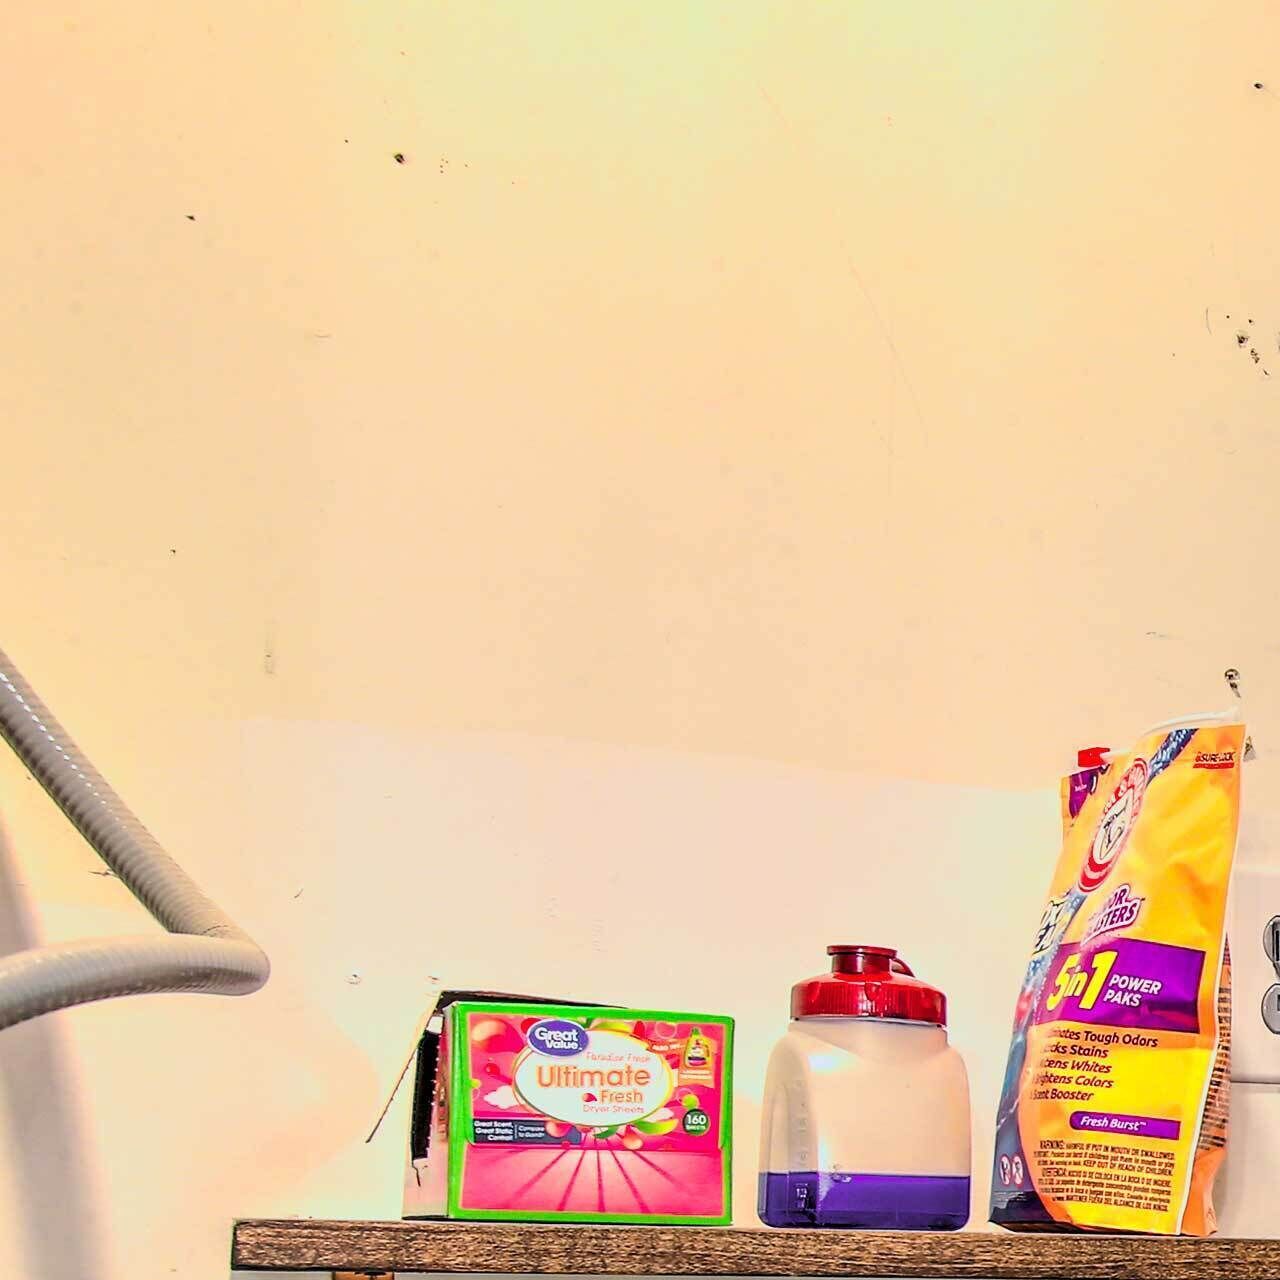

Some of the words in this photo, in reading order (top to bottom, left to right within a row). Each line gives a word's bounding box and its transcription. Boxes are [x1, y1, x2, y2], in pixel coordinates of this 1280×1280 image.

[1109, 975, 1162, 994] POWER
[1104, 990, 1141, 1007] PAKS
[534, 1028, 579, 1042] Great
[1084, 1031, 1119, 1045] Tough
[1122, 1034, 1158, 1048] Odors
[1069, 1044, 1109, 1058] Stains
[1071, 1060, 1112, 1073] Whites
[536, 1065, 651, 1088] Ultimate
[1075, 1075, 1114, 1088] Colors
[601, 1090, 643, 1105] Fresh
[1050, 1088, 1094, 1101] Booster
[582, 1104, 610, 1114] Dryer
[612, 1104, 645, 1114] Sheets
[687, 1115, 707, 1125] 160
[1080, 1116, 1108, 1127] Fresh
